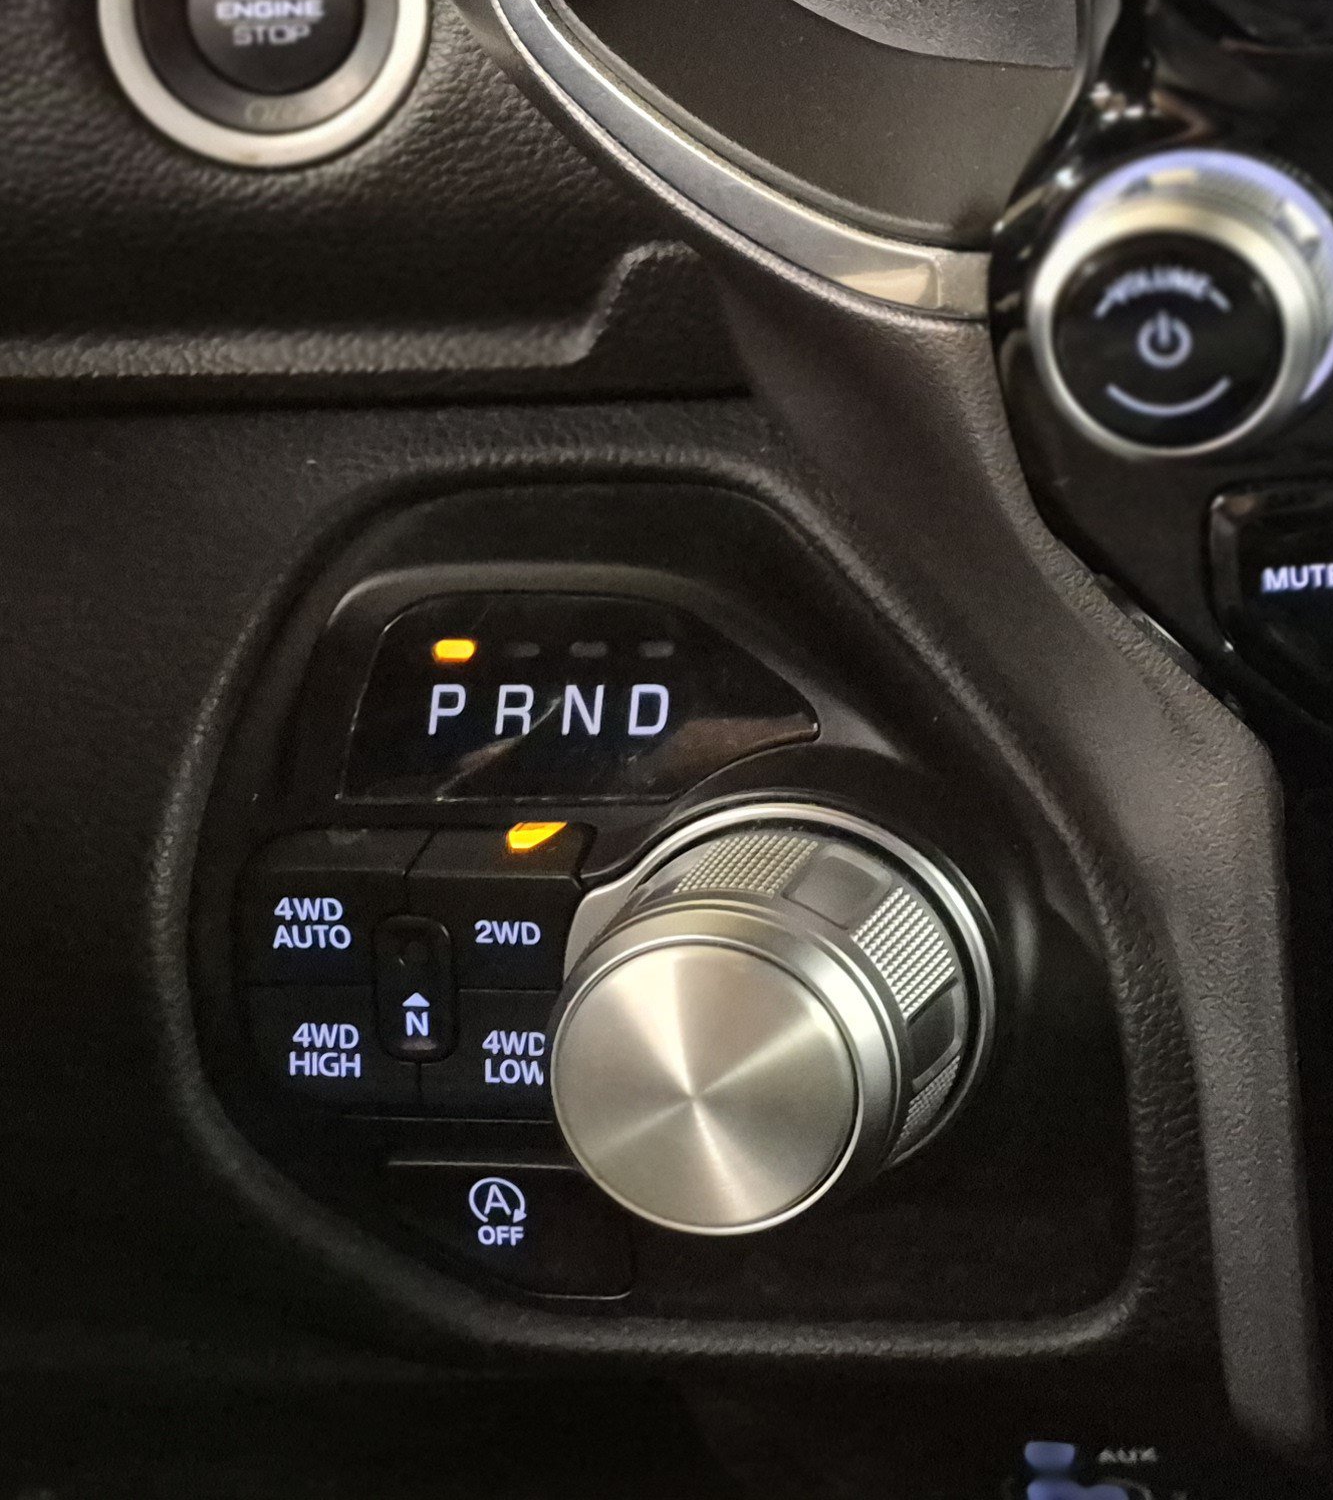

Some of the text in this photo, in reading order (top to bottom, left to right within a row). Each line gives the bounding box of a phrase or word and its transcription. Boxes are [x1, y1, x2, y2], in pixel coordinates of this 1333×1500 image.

[231, 23, 312, 47] STOP
[273, 896, 345, 923] 4WD
[272, 924, 352, 951] AUTO
[474, 919, 542, 947] 2WD
[292, 1022, 360, 1051] 4WD
[404, 1010, 430, 1038] N
[481, 1029, 546, 1058] 4WD
[288, 1052, 362, 1079] HIGH
[483, 1057, 545, 1086] LOW
[477, 1225, 525, 1247] OFF
